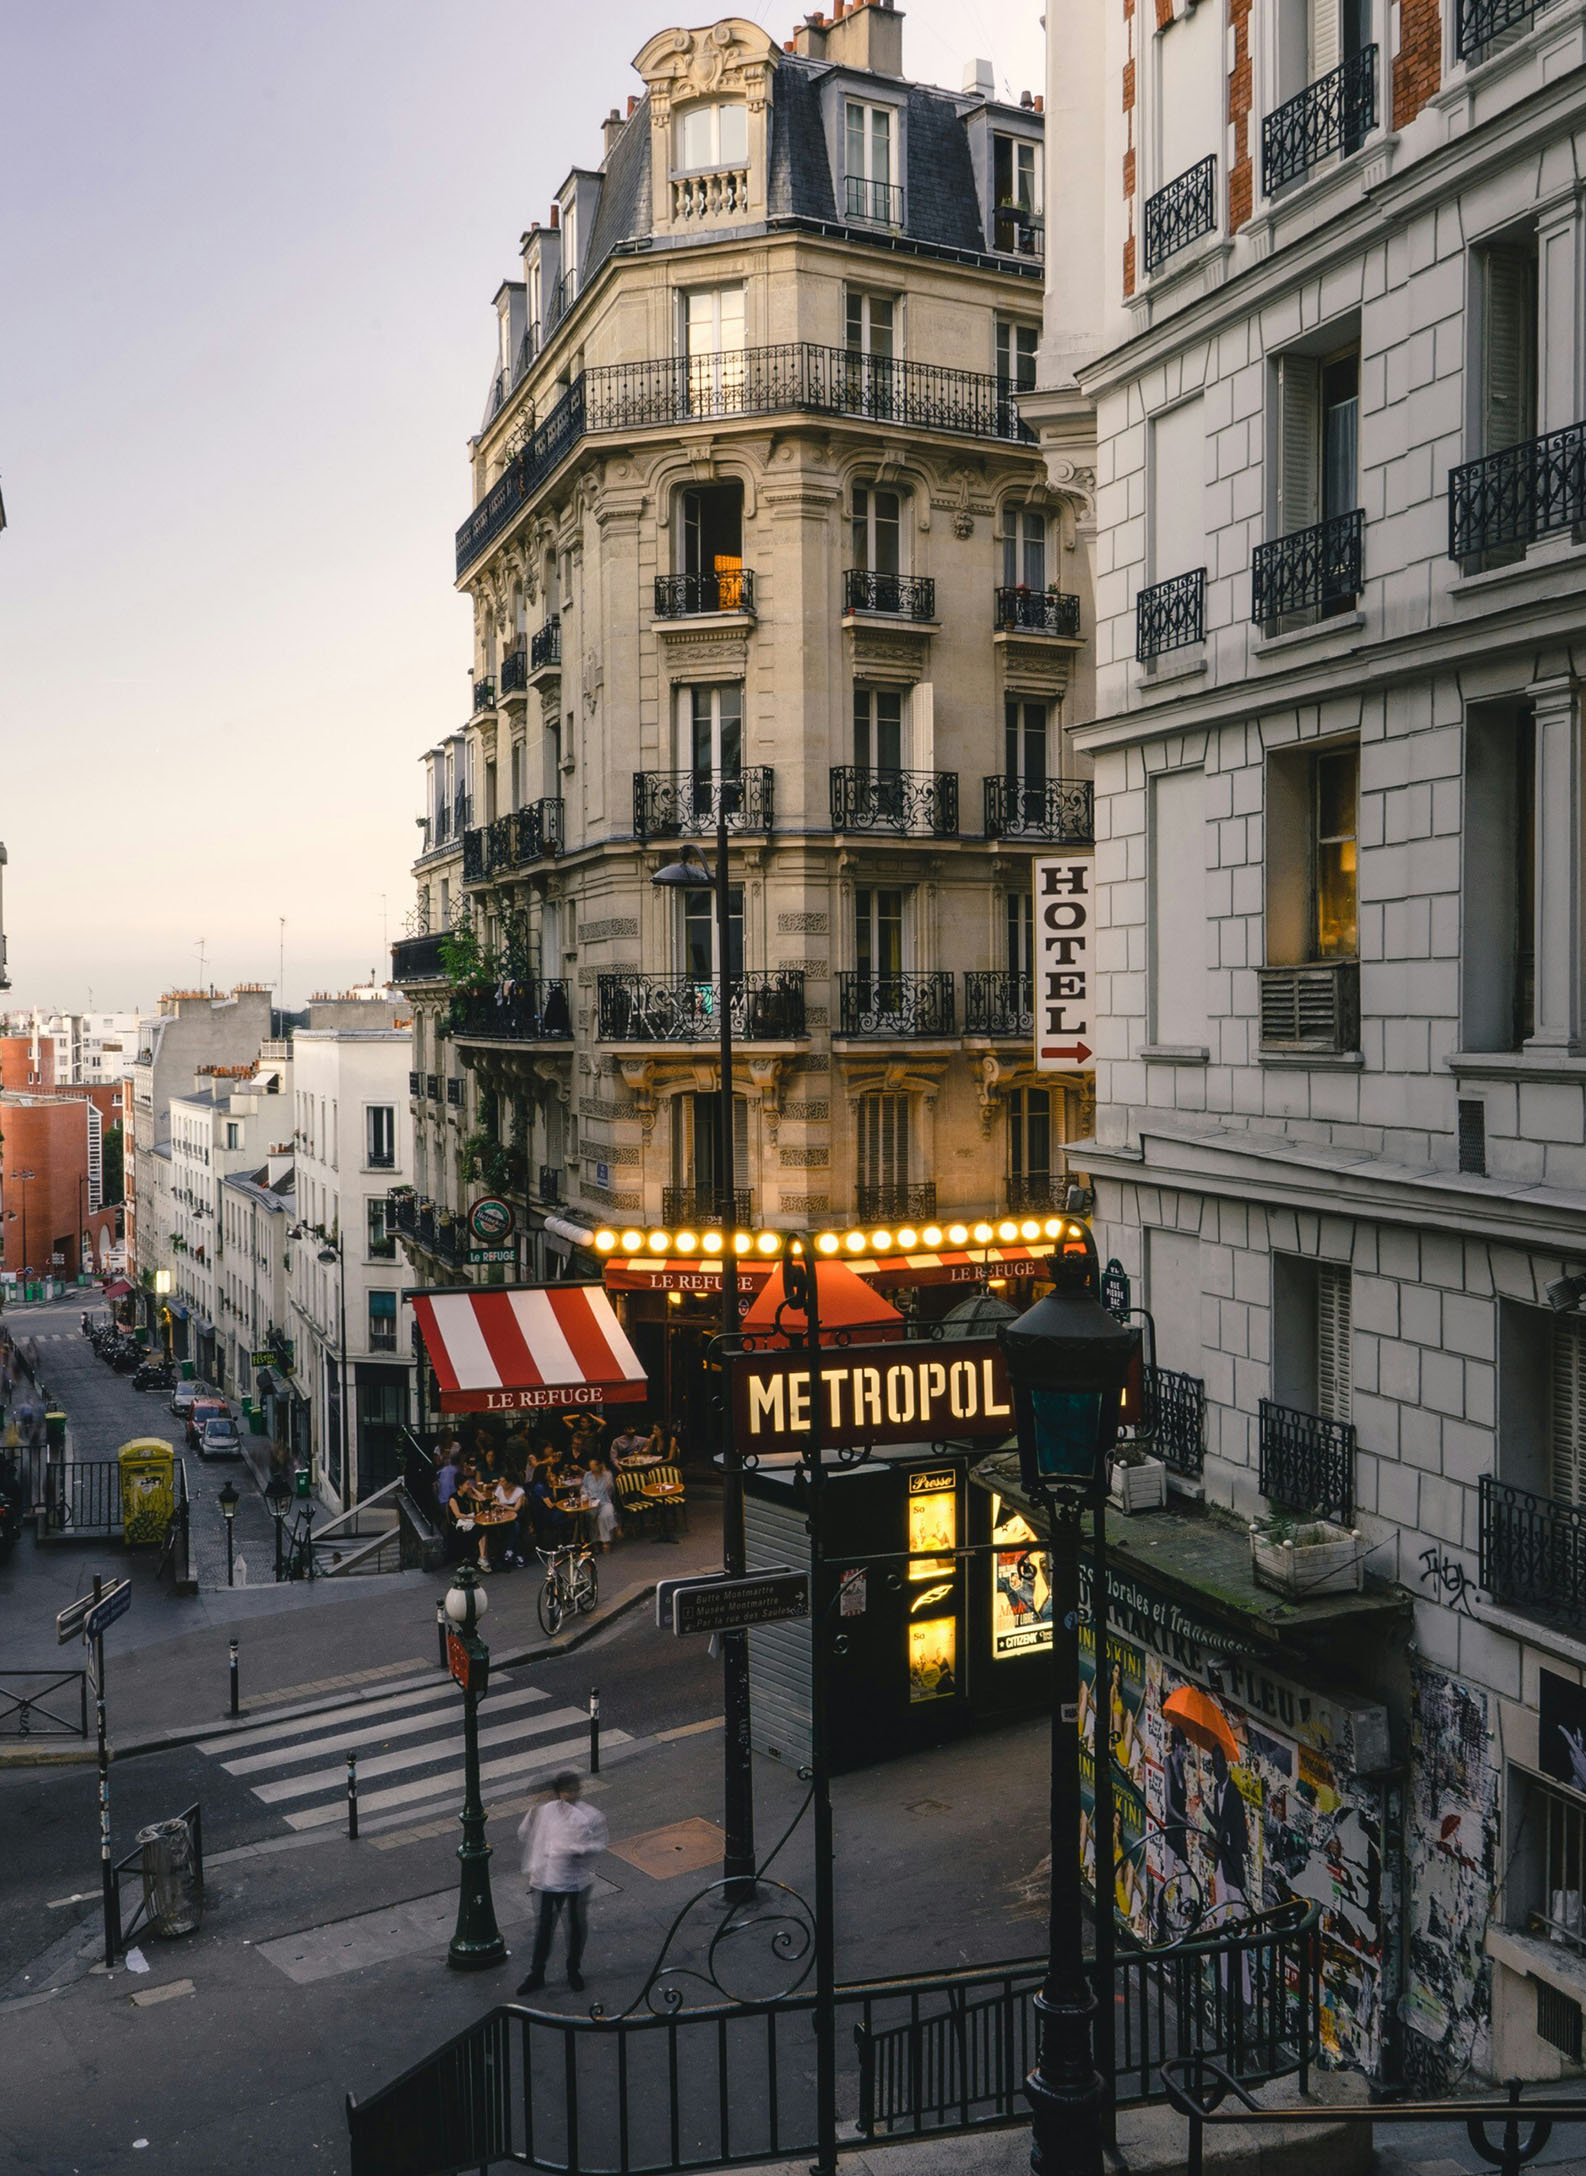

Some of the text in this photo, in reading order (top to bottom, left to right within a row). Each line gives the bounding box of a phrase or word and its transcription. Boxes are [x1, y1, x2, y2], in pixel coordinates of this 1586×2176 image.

[1041, 866, 1088, 1035] HOTEL
[470, 1250, 515, 1263] Le REFUGE
[950, 1267, 971, 1281] LE
[650, 1274, 753, 1291] LE REFUE
[486, 1387, 603, 1409] LE REFUGE
[912, 1474, 953, 1490] Presse
[724, 1585, 774, 1600] Montmartre
[1105, 1569, 1149, 1616] lorales
[1152, 1602, 1166, 1625] et
[728, 1597, 779, 1611] Montmartre
